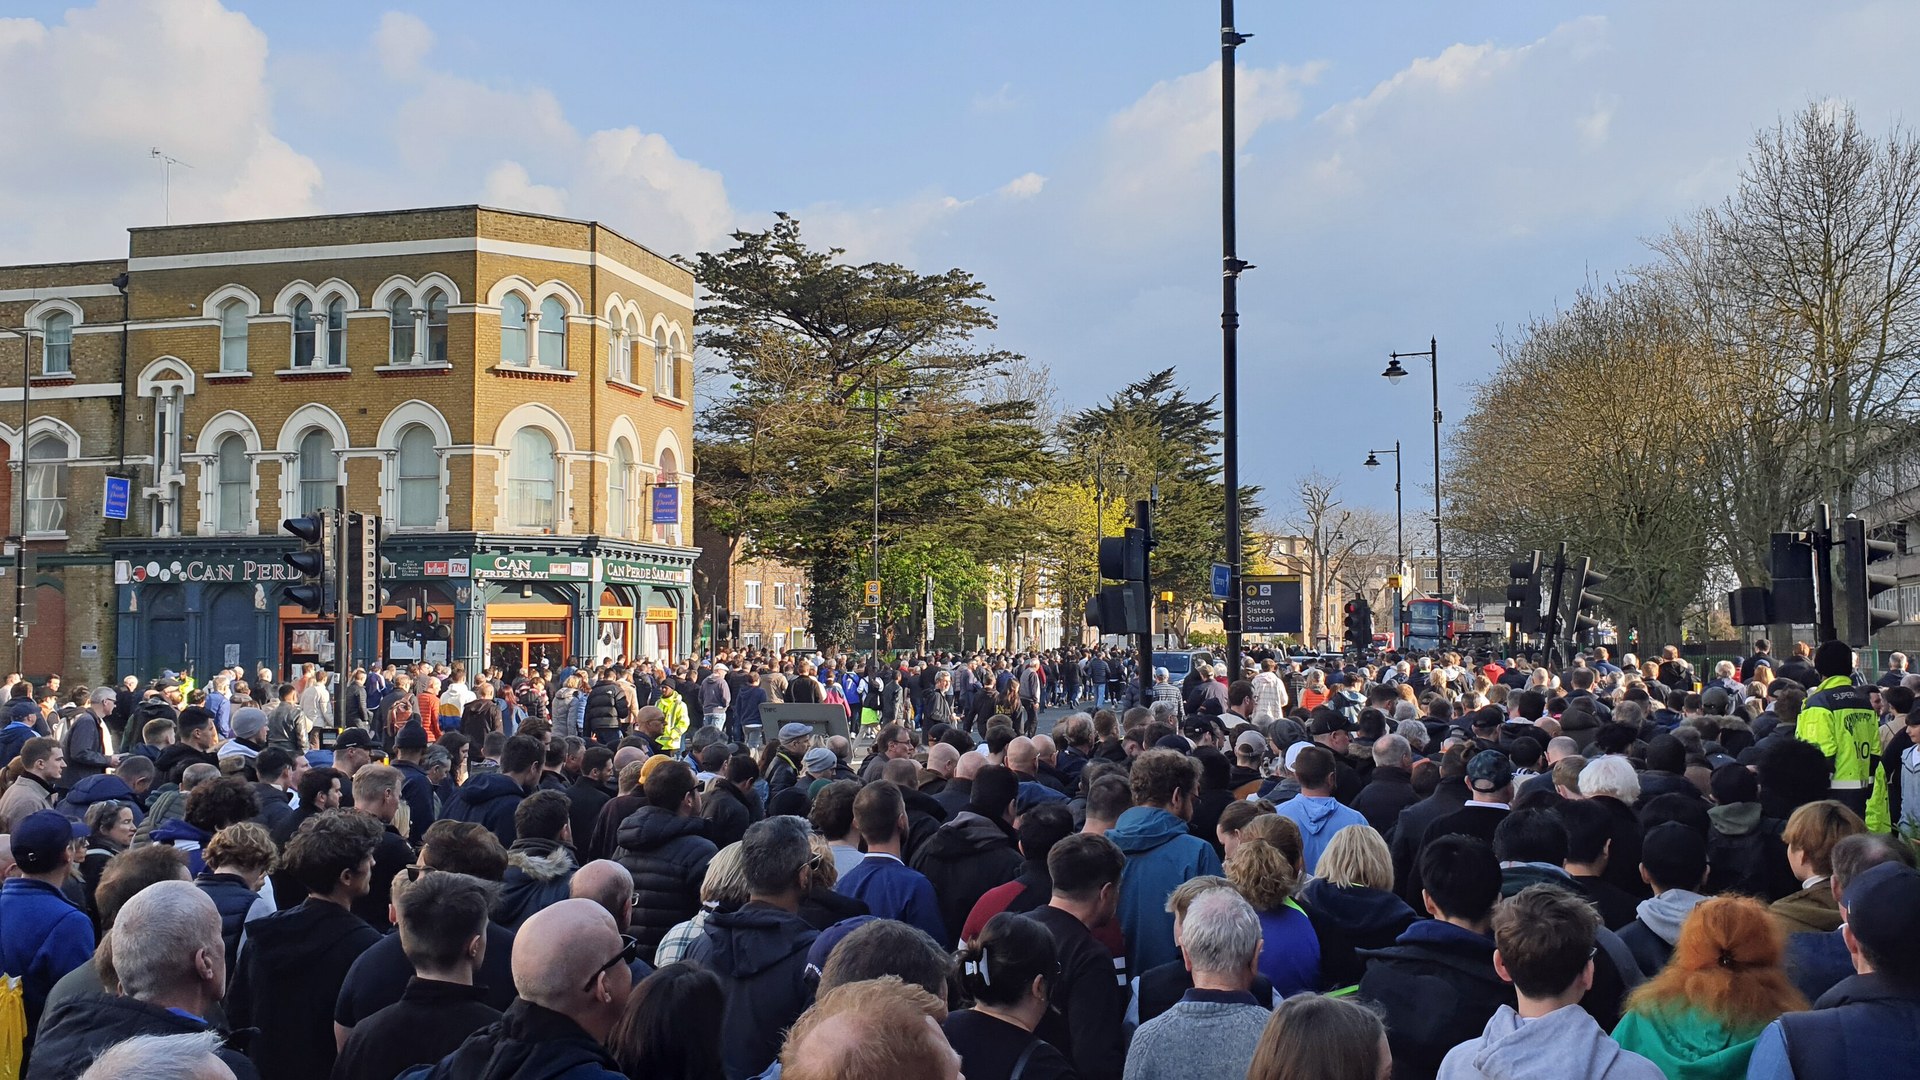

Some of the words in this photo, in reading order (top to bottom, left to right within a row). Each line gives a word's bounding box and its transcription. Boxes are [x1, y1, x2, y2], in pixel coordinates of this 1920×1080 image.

[243, 560, 302, 581] PERD
[475, 568, 510, 578] PERDE
[512, 569, 549, 579] SARAYI
[626, 564, 650, 579] PERDE
[1246, 598, 1270, 606] Seven
